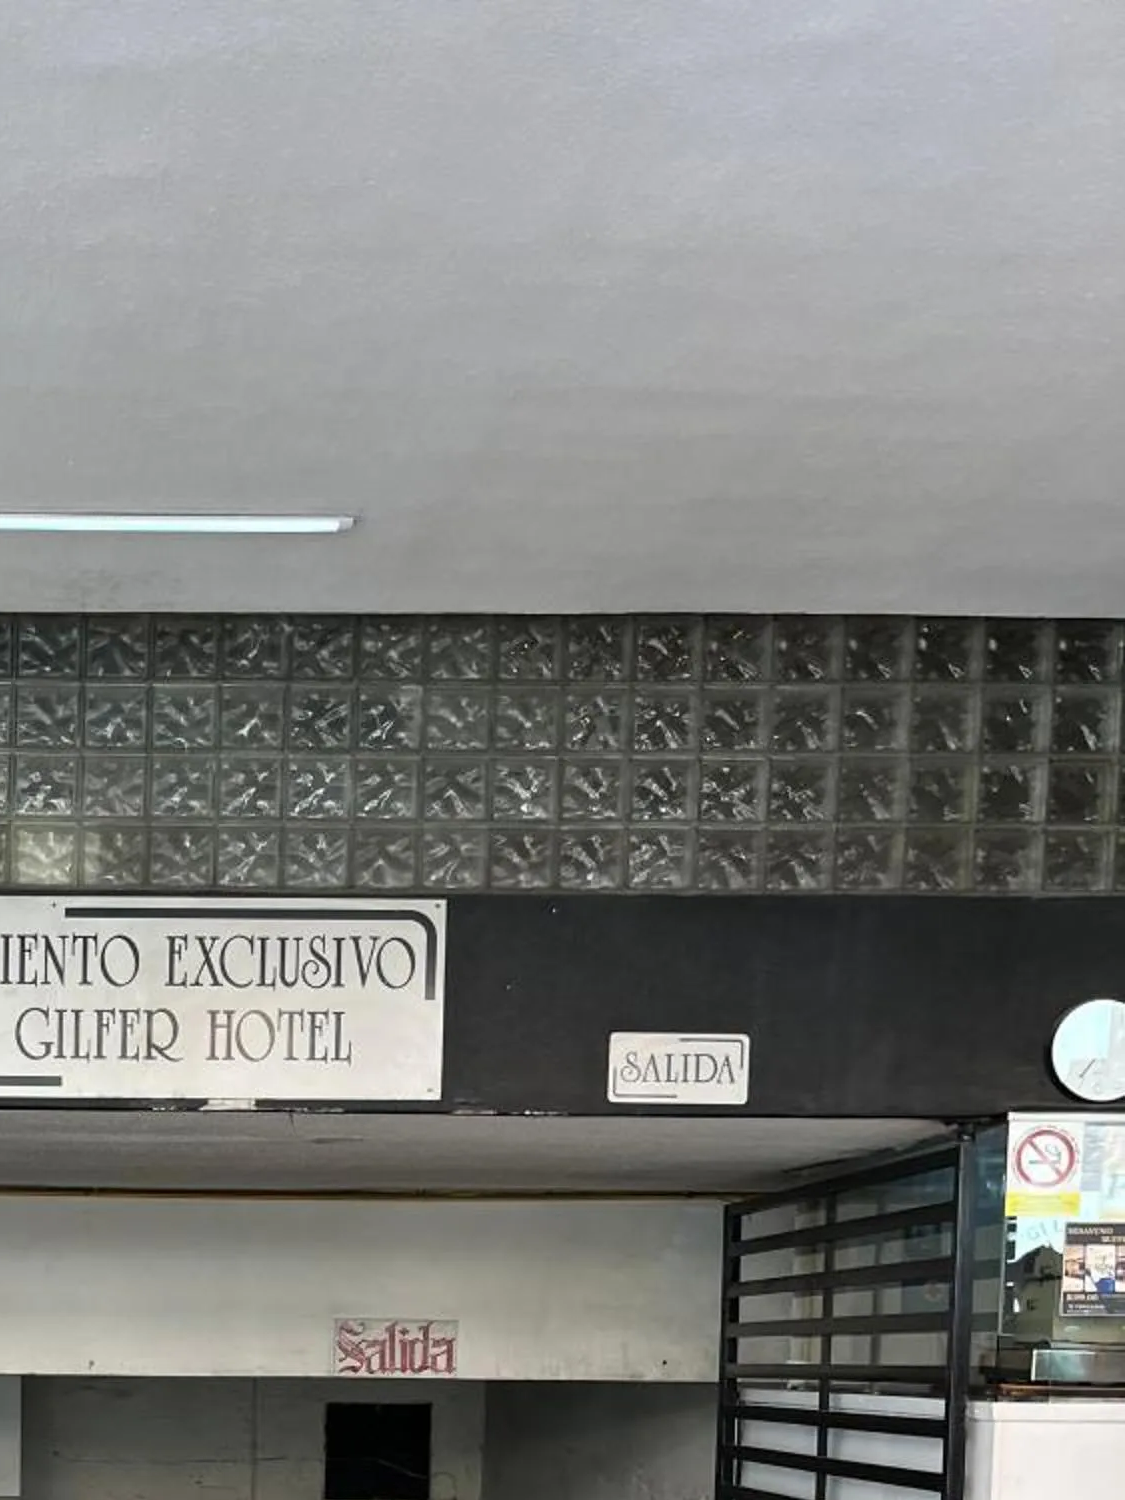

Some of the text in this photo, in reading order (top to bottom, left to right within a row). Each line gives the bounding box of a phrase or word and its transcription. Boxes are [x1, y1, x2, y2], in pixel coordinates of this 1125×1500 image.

[164, 934, 416, 990] EXCLUSIVO
[15, 1006, 181, 1064] GILFER
[206, 1009, 352, 1064] HOTEL
[620, 1051, 735, 1084] SALIDA
[336, 1319, 456, 1374] Salida
